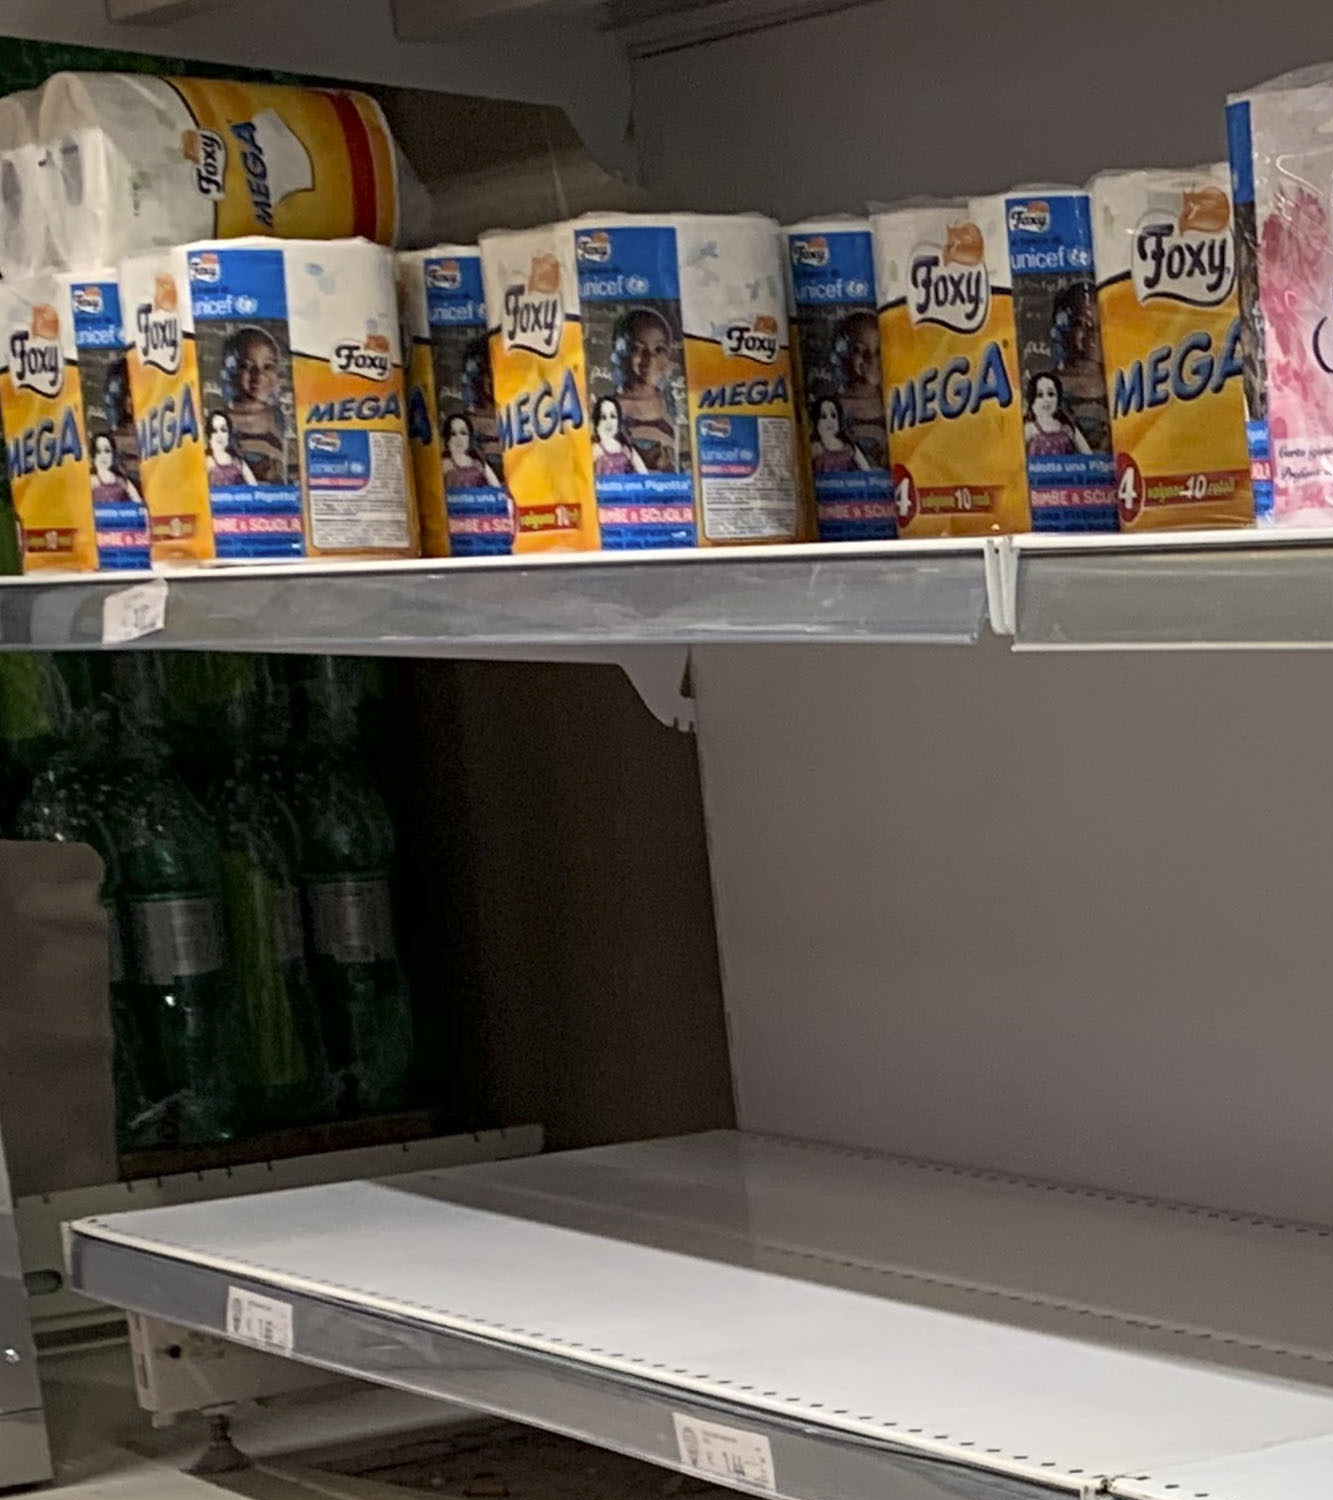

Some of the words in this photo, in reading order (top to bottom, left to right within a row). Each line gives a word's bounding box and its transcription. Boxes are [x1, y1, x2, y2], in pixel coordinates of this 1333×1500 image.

[231, 122, 273, 232] MEGA
[1011, 212, 1047, 230] Foxy
[1011, 247, 1064, 269] unicef
[1137, 223, 1227, 293] Foxy
[911, 254, 982, 321] Foxy
[137, 304, 179, 361] Foxy
[505, 284, 557, 346] Foxy
[11, 330, 59, 386] Foxy
[335, 345, 388, 376] Foxy
[726, 326, 778, 358] Foxy
[890, 340, 1013, 433] MEGA
[1113, 316, 1243, 420] MEGA
[306, 393, 401, 424] MEGA
[698, 375, 788, 408] MEGA
[895, 478, 911, 516] 4
[955, 488, 971, 511] 10
[1118, 467, 1137, 509] 4
[1186, 475, 1207, 499] 10
